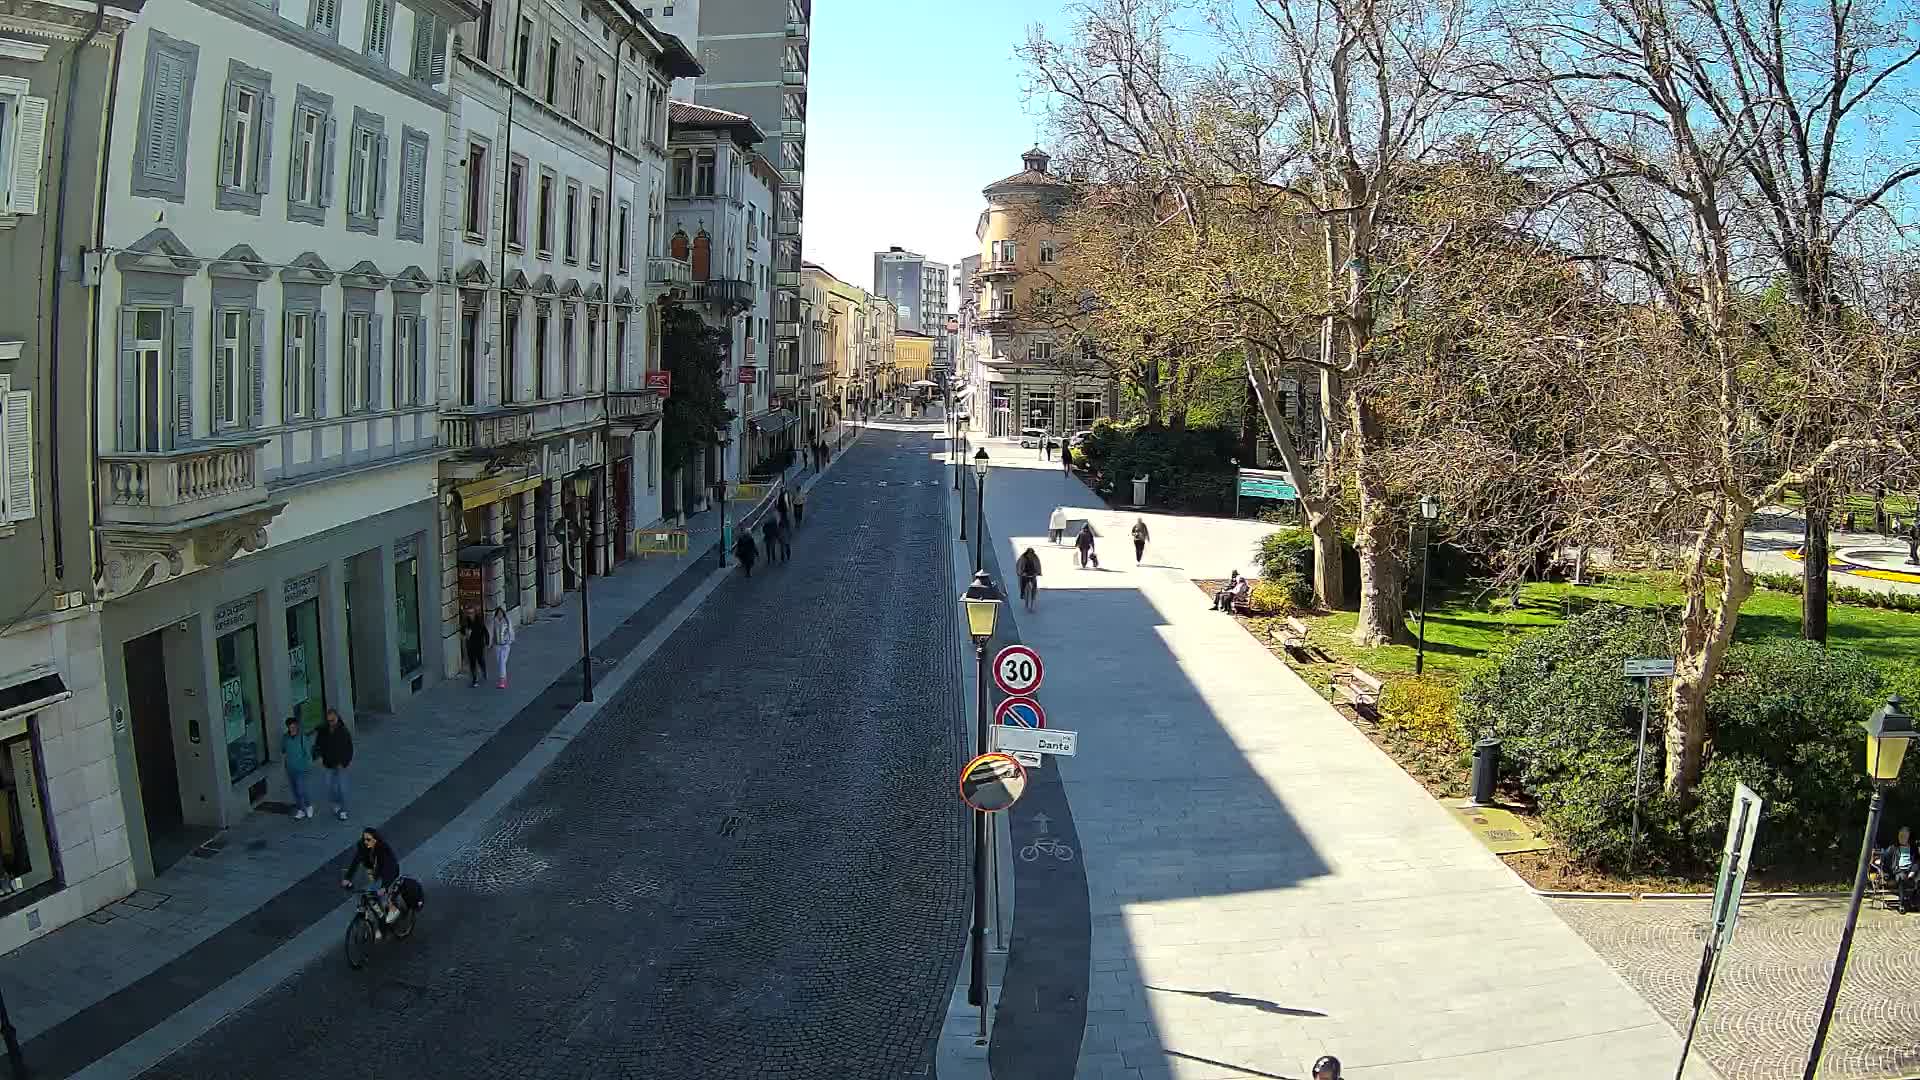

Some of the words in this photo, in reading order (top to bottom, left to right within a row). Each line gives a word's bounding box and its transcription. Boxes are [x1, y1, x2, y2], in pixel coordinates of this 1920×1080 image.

[1005, 659, 1033, 682] 30
[223, 680, 241, 704] 130
[1038, 739, 1070, 751] Dante
